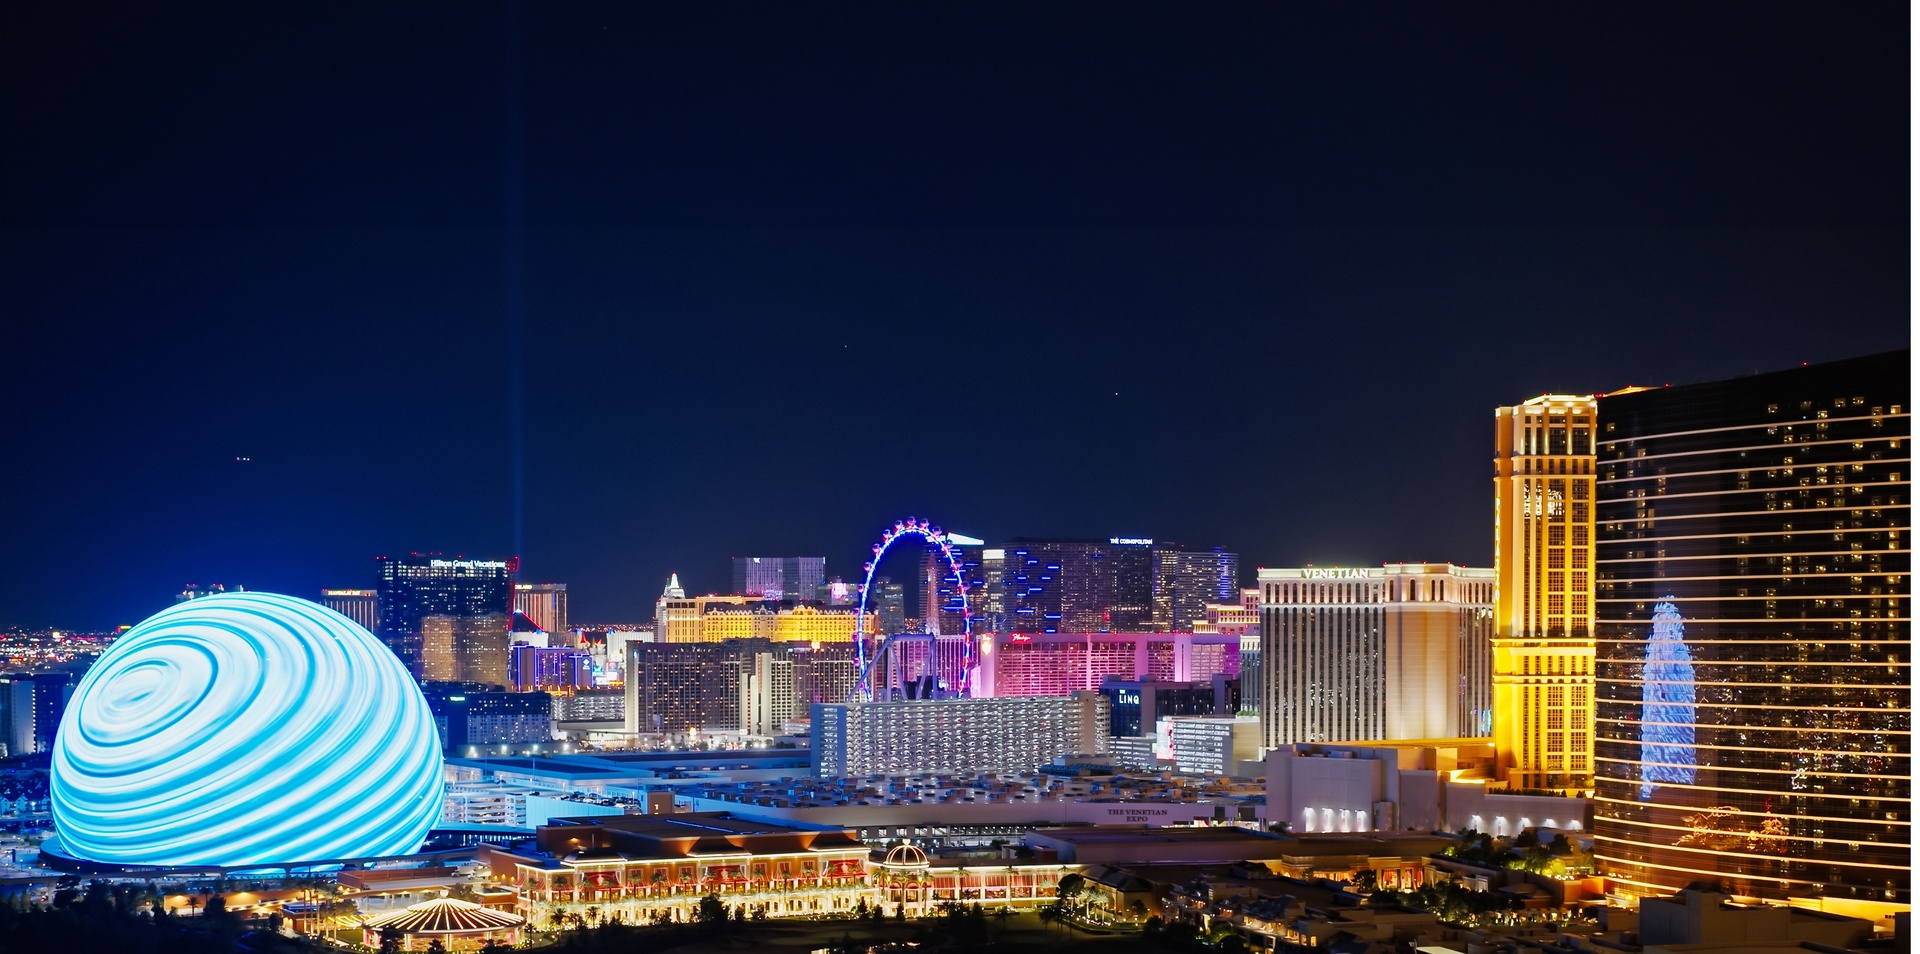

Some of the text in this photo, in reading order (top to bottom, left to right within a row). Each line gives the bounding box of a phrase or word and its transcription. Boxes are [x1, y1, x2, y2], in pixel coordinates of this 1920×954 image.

[474, 560, 506, 568] Vacations
[1302, 568, 1369, 579] VENETIAN
[1119, 694, 1140, 705] LINQ
